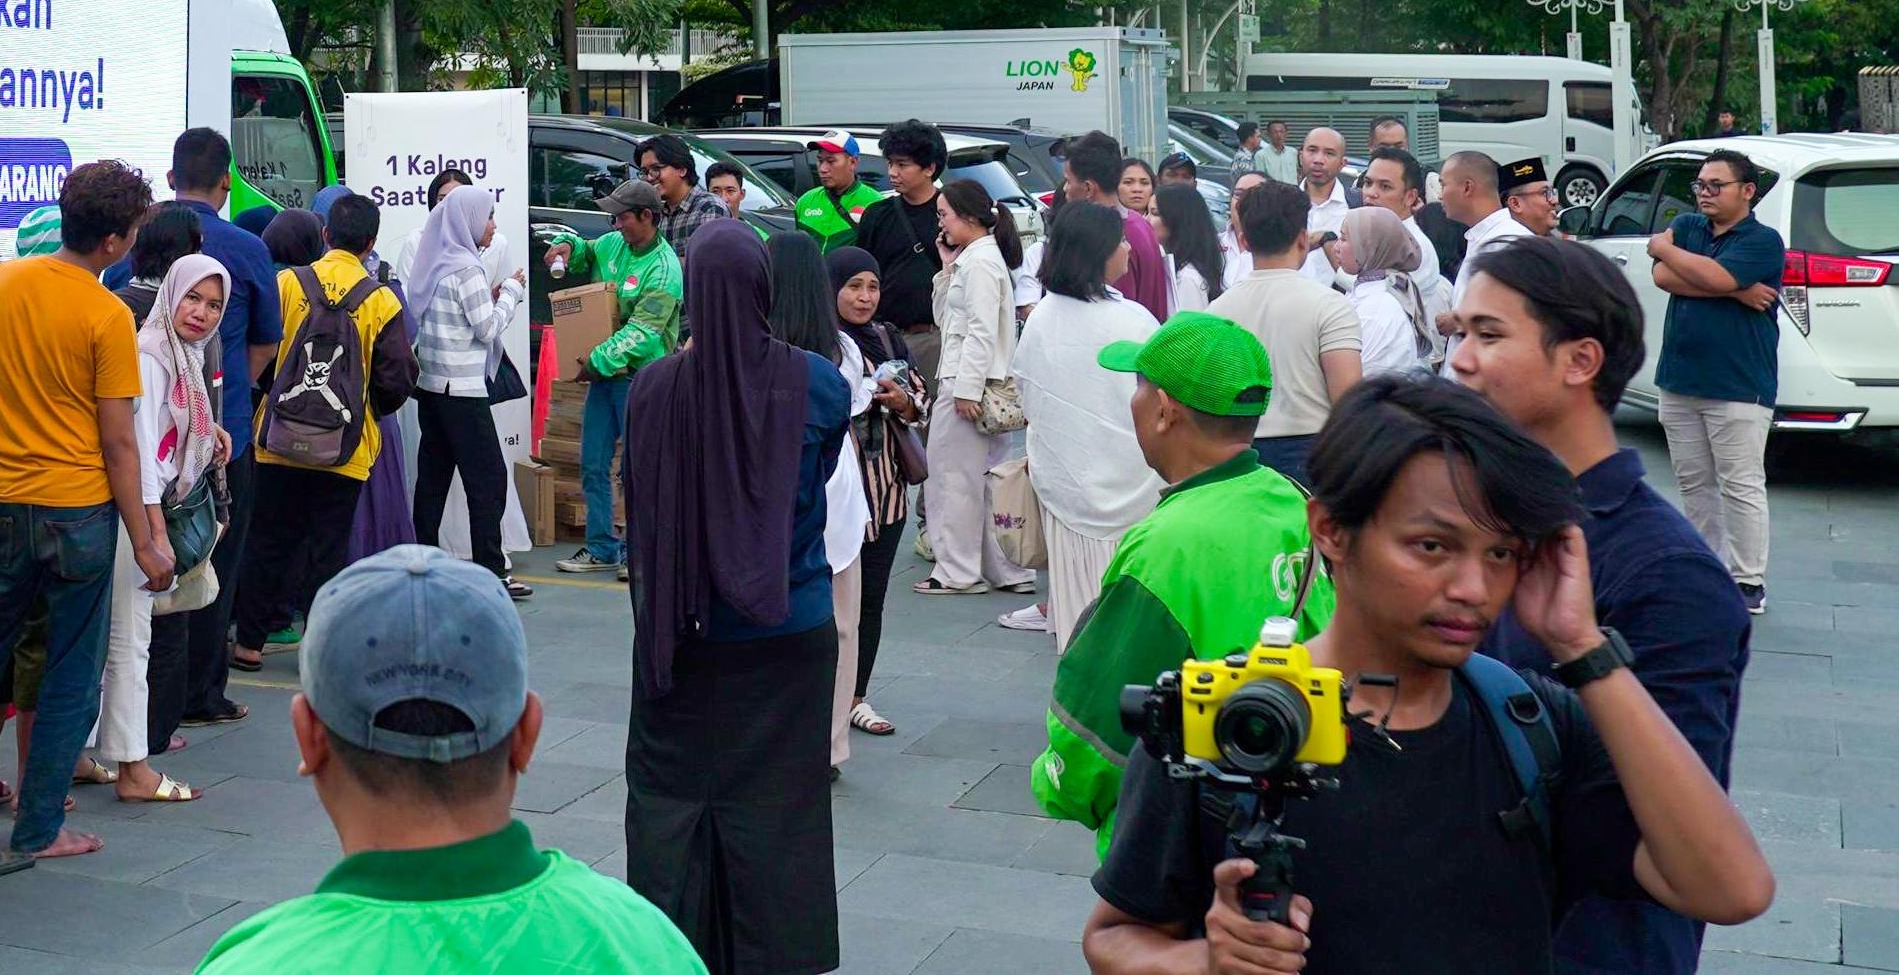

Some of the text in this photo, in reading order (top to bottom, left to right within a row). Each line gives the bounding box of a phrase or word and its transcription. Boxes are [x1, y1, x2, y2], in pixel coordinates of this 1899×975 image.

[1006, 60, 1060, 76] LION
[1016, 81, 1054, 91] JAPAN
[386, 154, 487, 178] 1 Kaleng
[371, 186, 426, 207] Saat
[804, 207, 823, 217] Grab
